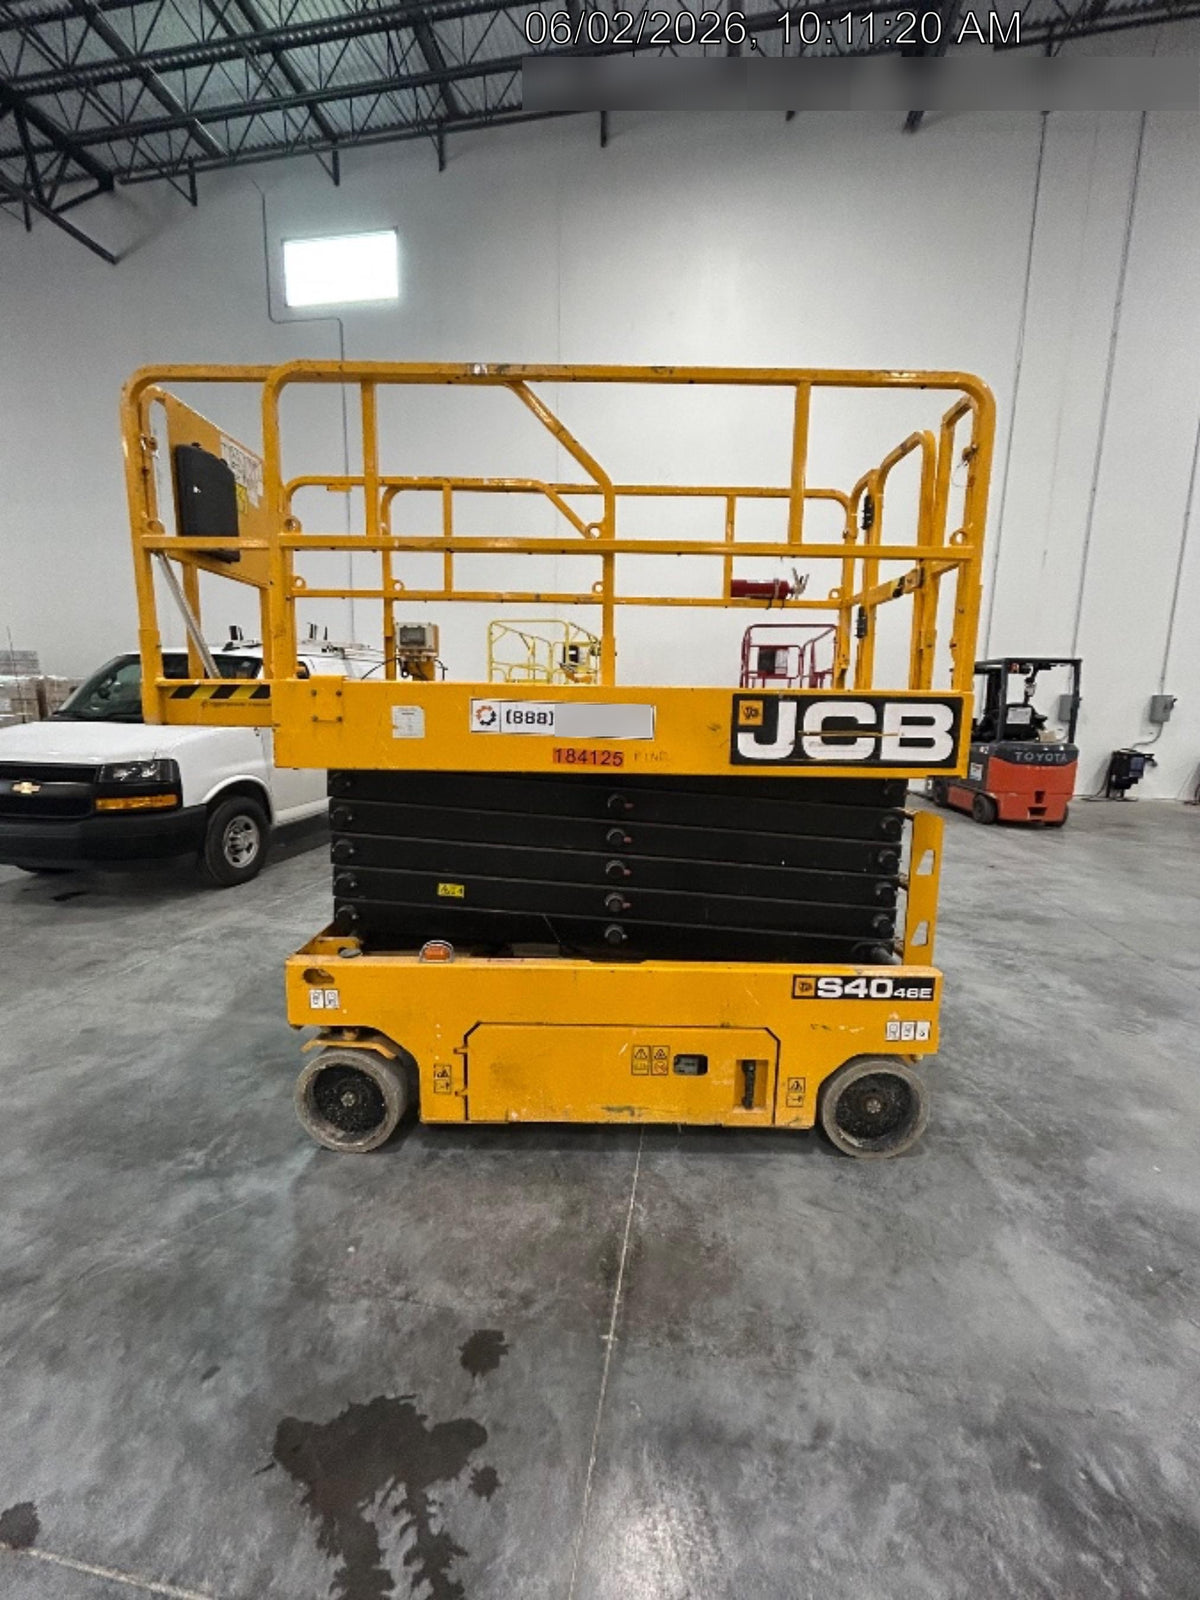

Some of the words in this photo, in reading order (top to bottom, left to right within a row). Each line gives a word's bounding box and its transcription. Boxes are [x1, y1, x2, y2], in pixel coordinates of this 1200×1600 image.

[737, 701, 954, 761] JCB
[555, 748, 624, 766] 184125
[1015, 752, 1068, 762] TOYOTA
